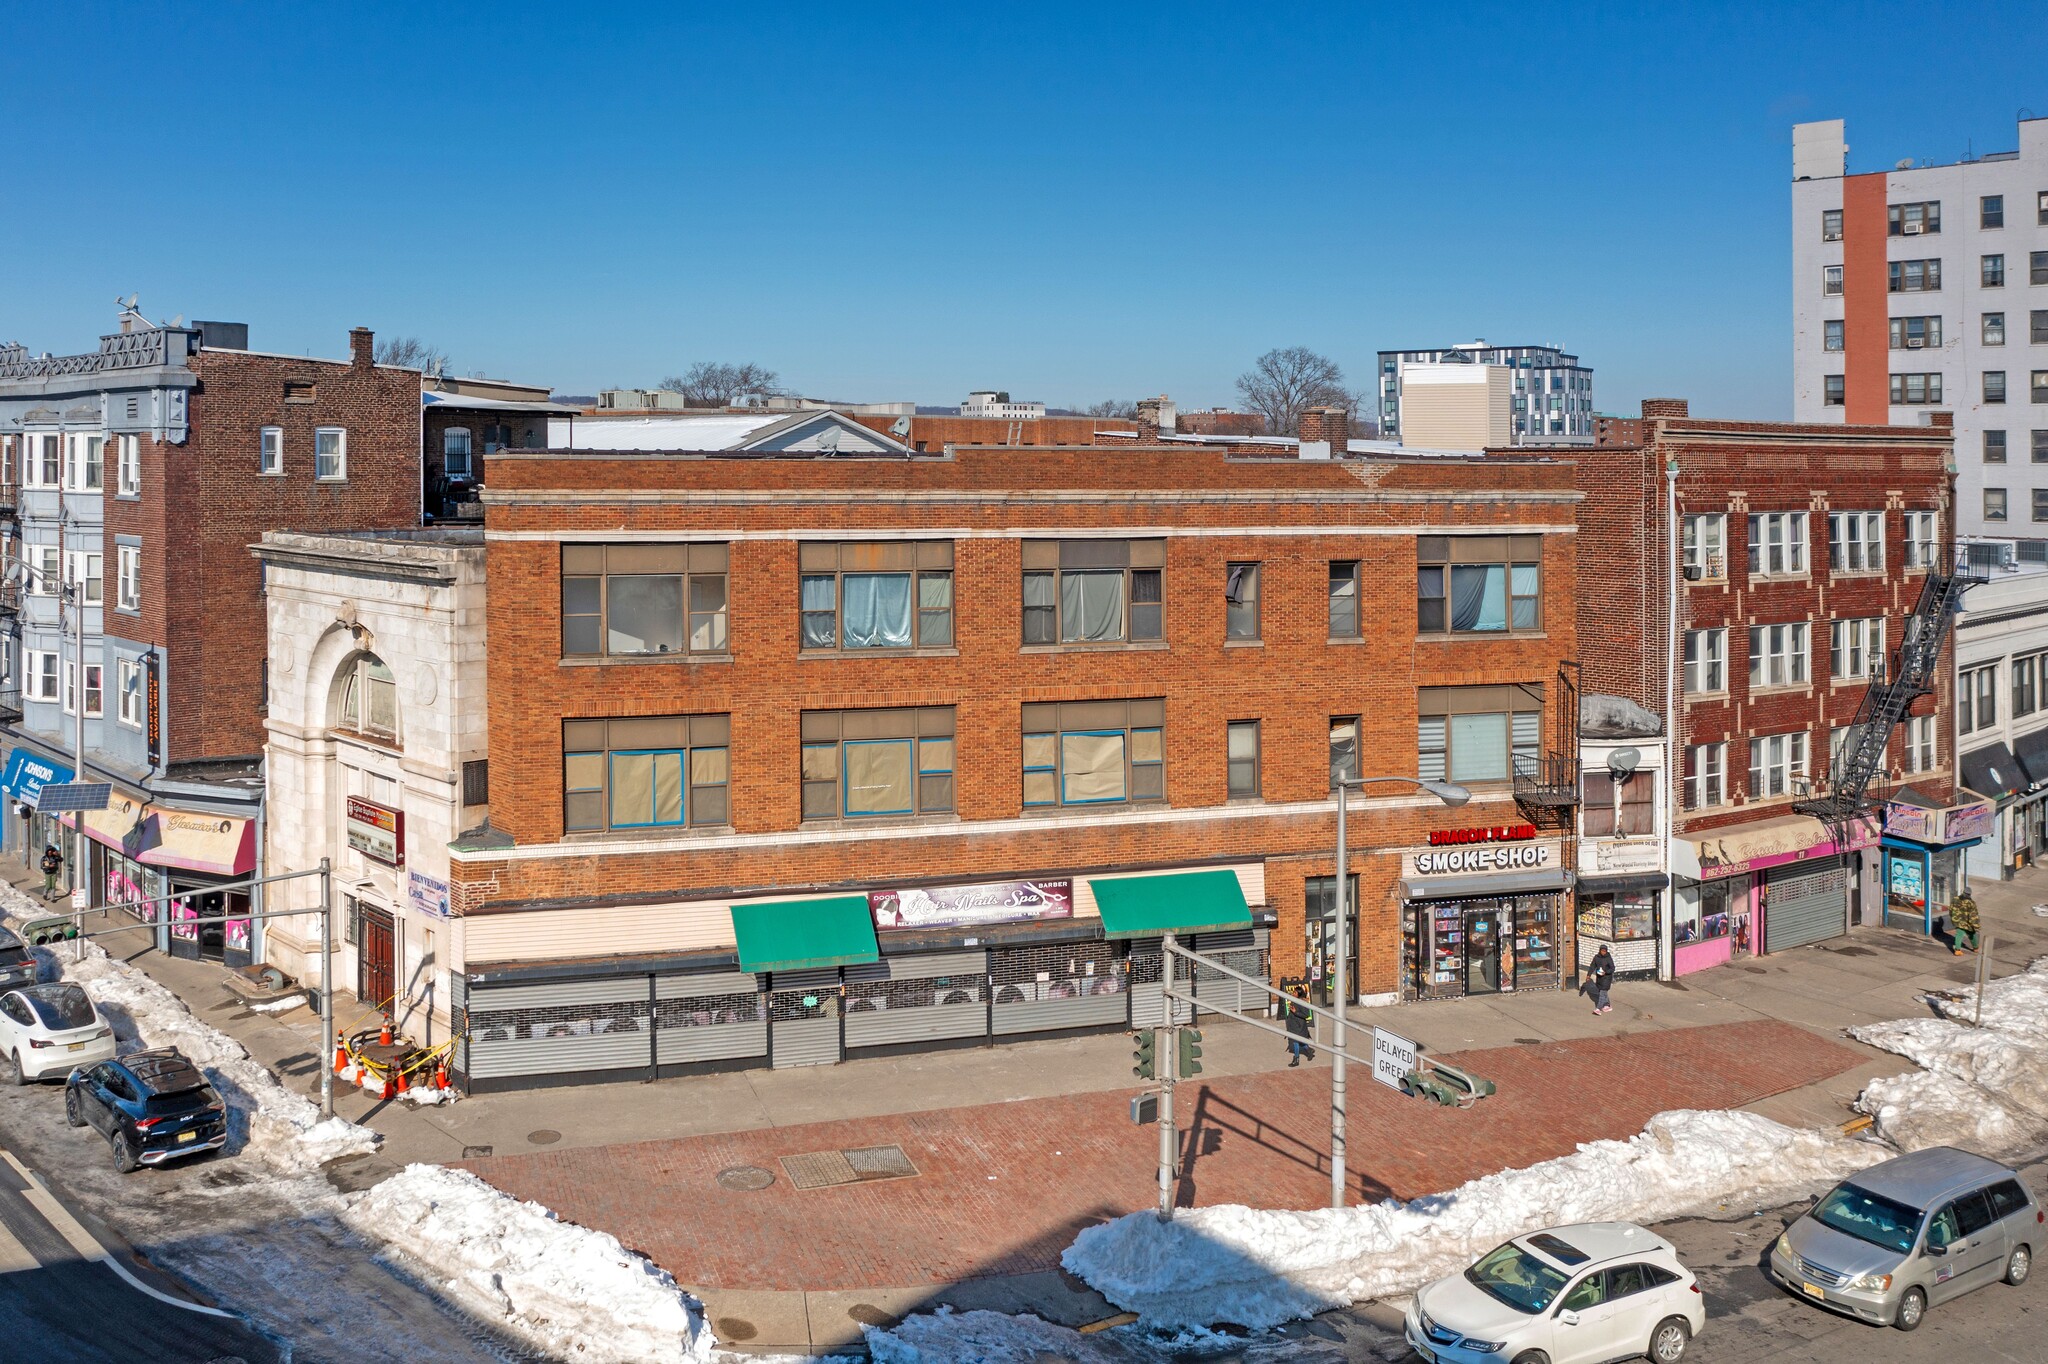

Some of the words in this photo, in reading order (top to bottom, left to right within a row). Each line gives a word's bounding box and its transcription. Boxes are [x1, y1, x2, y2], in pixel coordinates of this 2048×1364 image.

[24, 761, 53, 782] JOHNSON'S
[1895, 806, 1921, 818] Lincoln
[1430, 828, 1488, 845] DRAGON
[1491, 825, 1537, 841] FLAME
[1738, 839, 1786, 858] Beauty
[1794, 832, 1832, 850] Salon
[1419, 850, 1490, 872] SMOKE
[1495, 847, 1549, 867] SHOP
[410, 872, 448, 894] BIENVENIDOS
[1038, 881, 1068, 889] BARBER
[905, 895, 949, 915] Hair
[951, 892, 1000, 911] Nails
[1004, 889, 1040, 908] Spa
[897, 919, 924, 927] RELAXER
[1376, 1037, 1413, 1064] DELAYED
